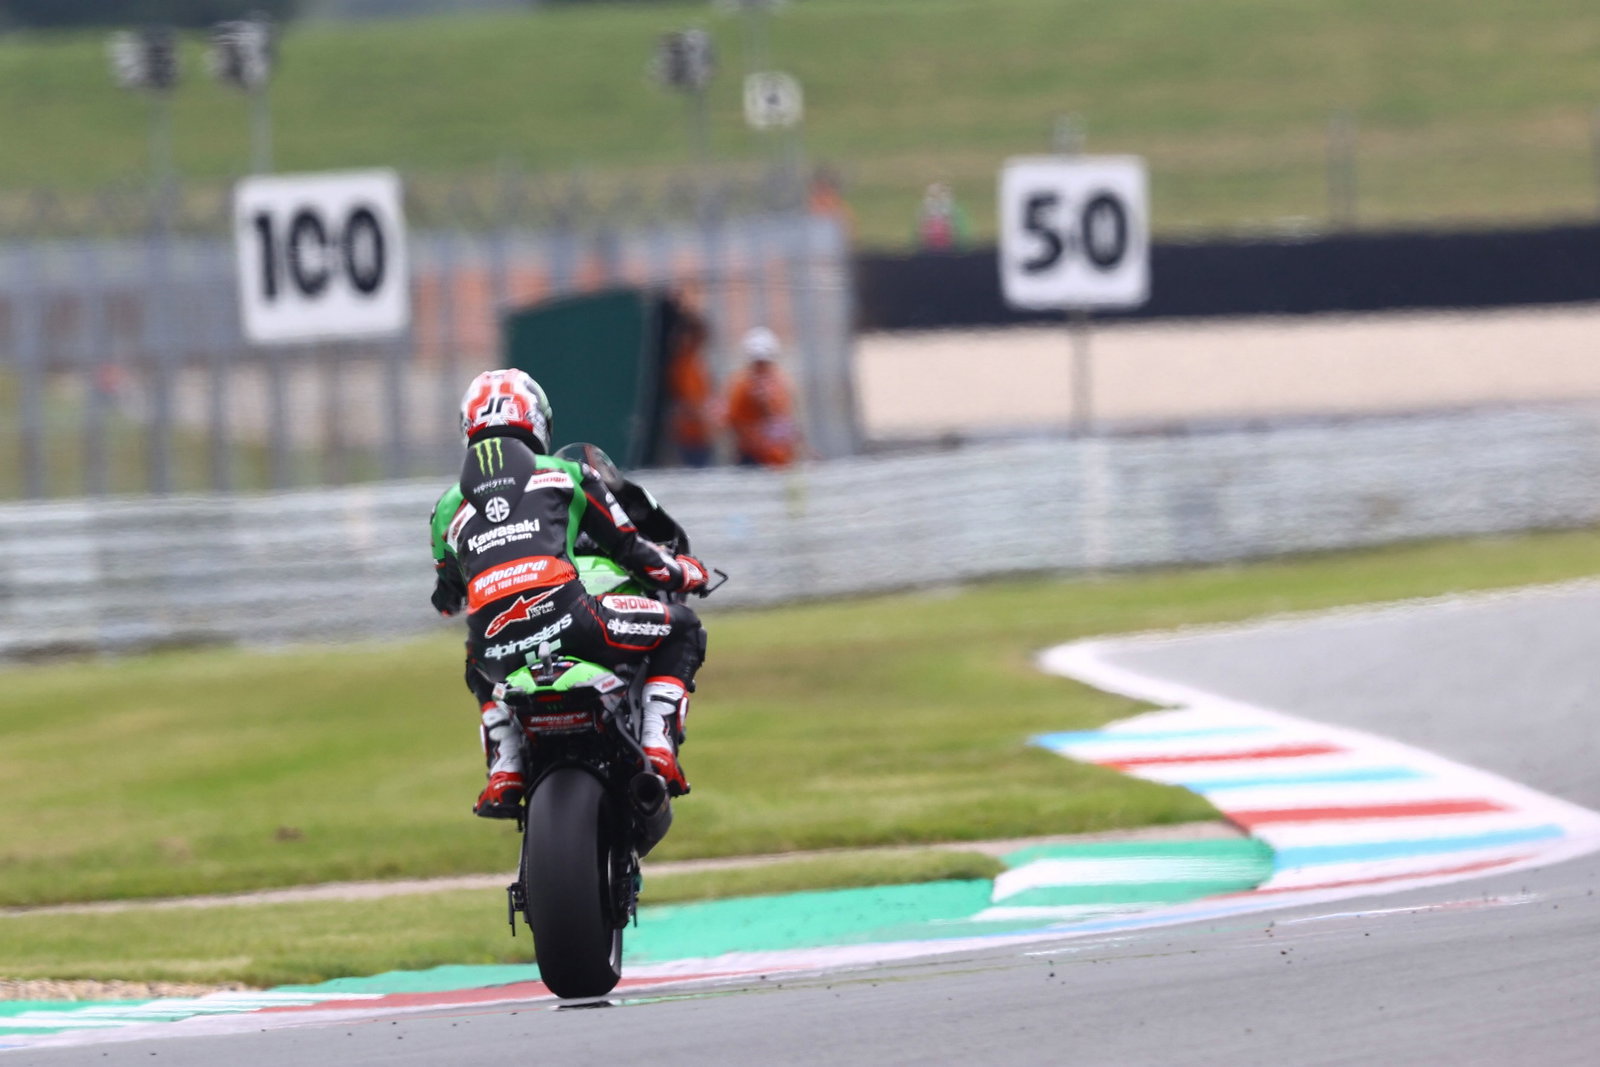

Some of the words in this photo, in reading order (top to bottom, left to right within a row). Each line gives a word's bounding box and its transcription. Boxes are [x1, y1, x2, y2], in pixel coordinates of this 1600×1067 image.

[1021, 190, 1128, 275] 50
[468, 518, 540, 551] Kawasaki
[476, 538, 506, 555] Racing
[506, 532, 533, 543] Team
[484, 585, 497, 597] FUEL
[498, 578, 513, 590] YOUR
[513, 572, 539, 585] PASSION
[613, 598, 660, 609] SHOWA
[484, 613, 573, 660] alpinestars
